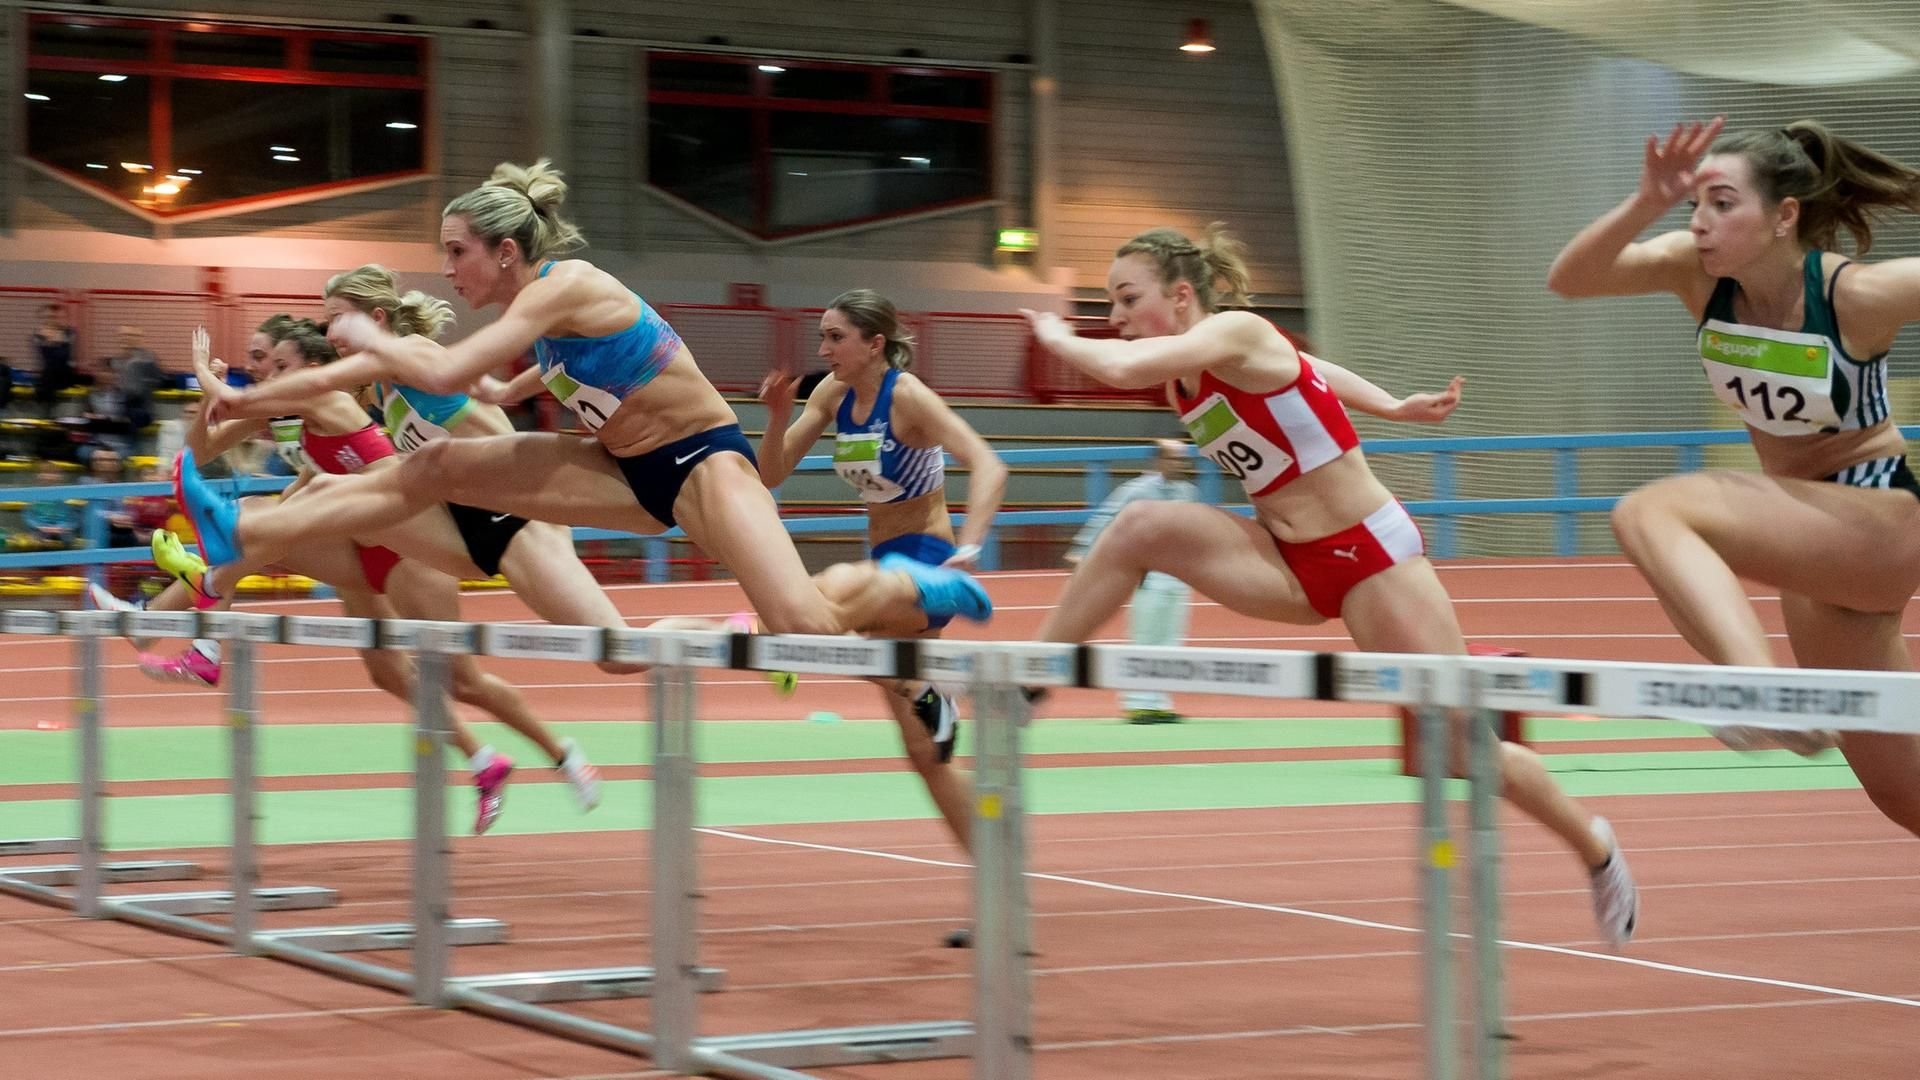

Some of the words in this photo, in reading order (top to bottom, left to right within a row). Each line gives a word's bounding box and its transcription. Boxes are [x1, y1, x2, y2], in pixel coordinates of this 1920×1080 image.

[1725, 376, 1811, 424] 112
[1639, 681, 1759, 711] STADION
[1765, 685, 1879, 717] ERFURT
